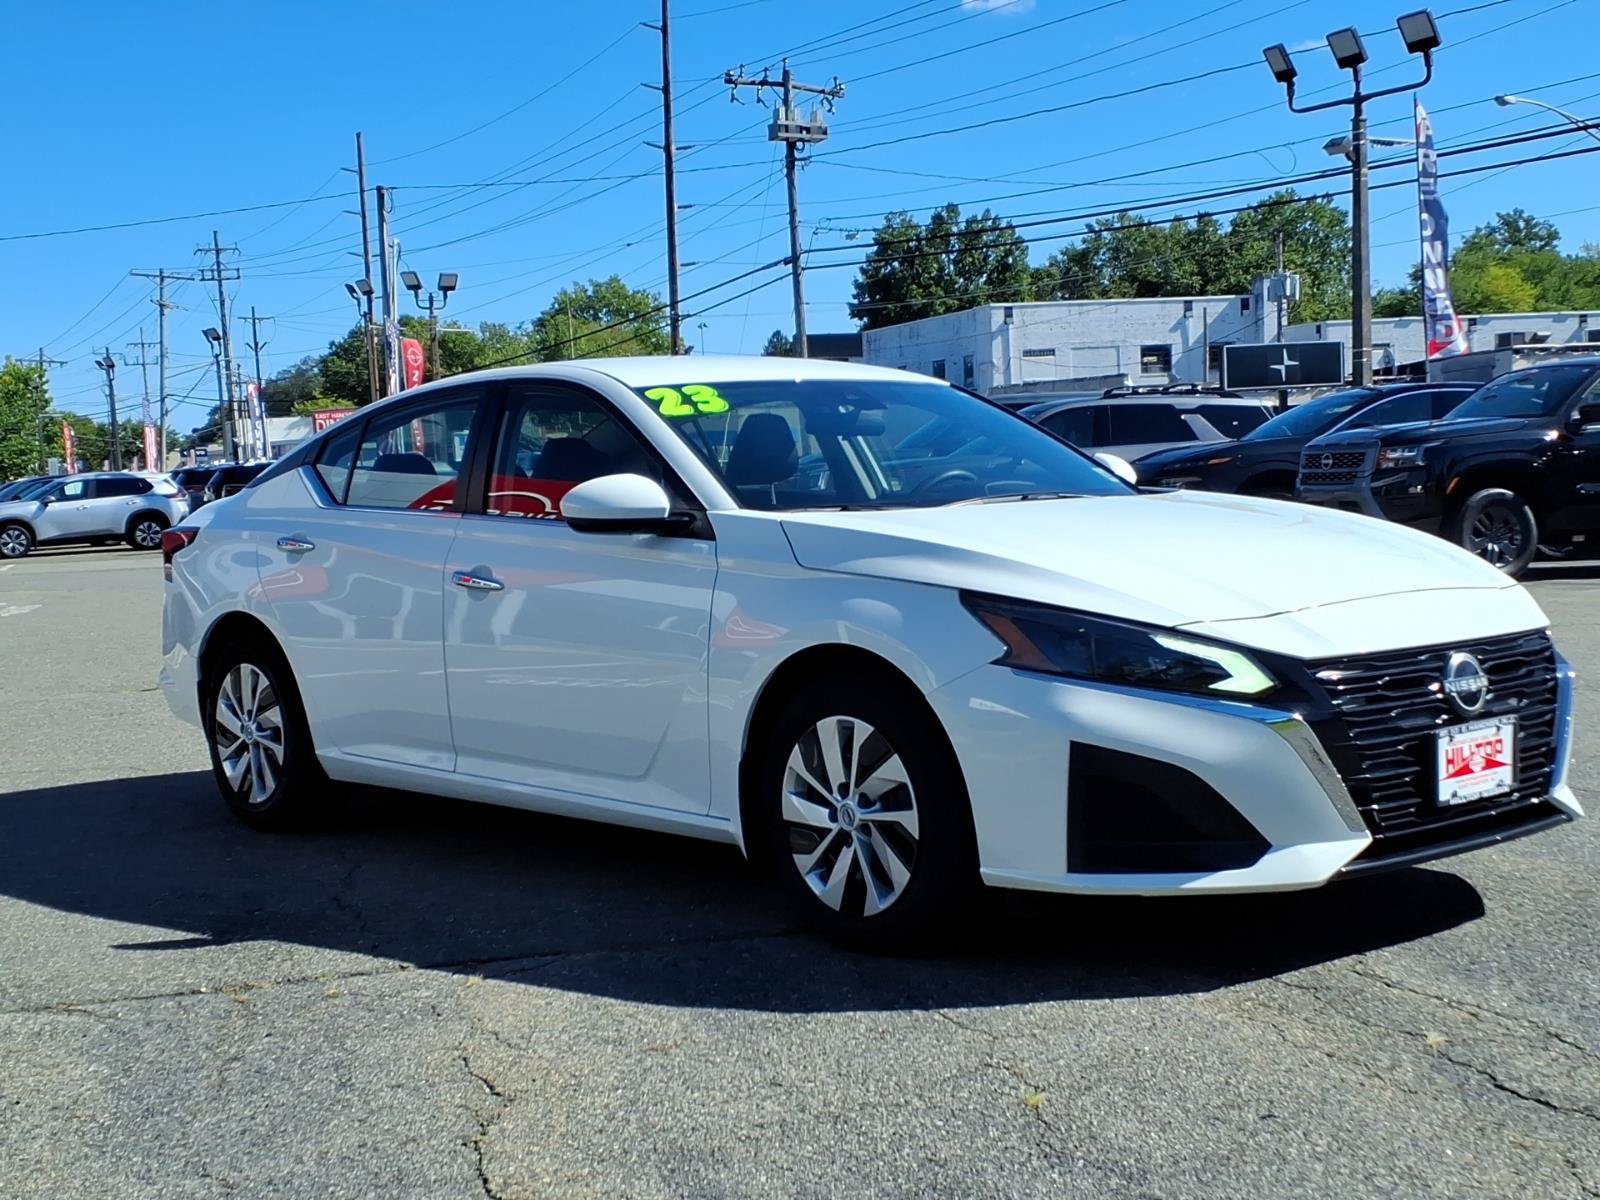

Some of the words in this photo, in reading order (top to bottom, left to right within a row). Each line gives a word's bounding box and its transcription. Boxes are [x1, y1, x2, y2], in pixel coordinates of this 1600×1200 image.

[644, 384, 730, 417] 23
[1444, 677, 1488, 693] NISSAN
[1445, 738, 1504, 776] HILLTOP
